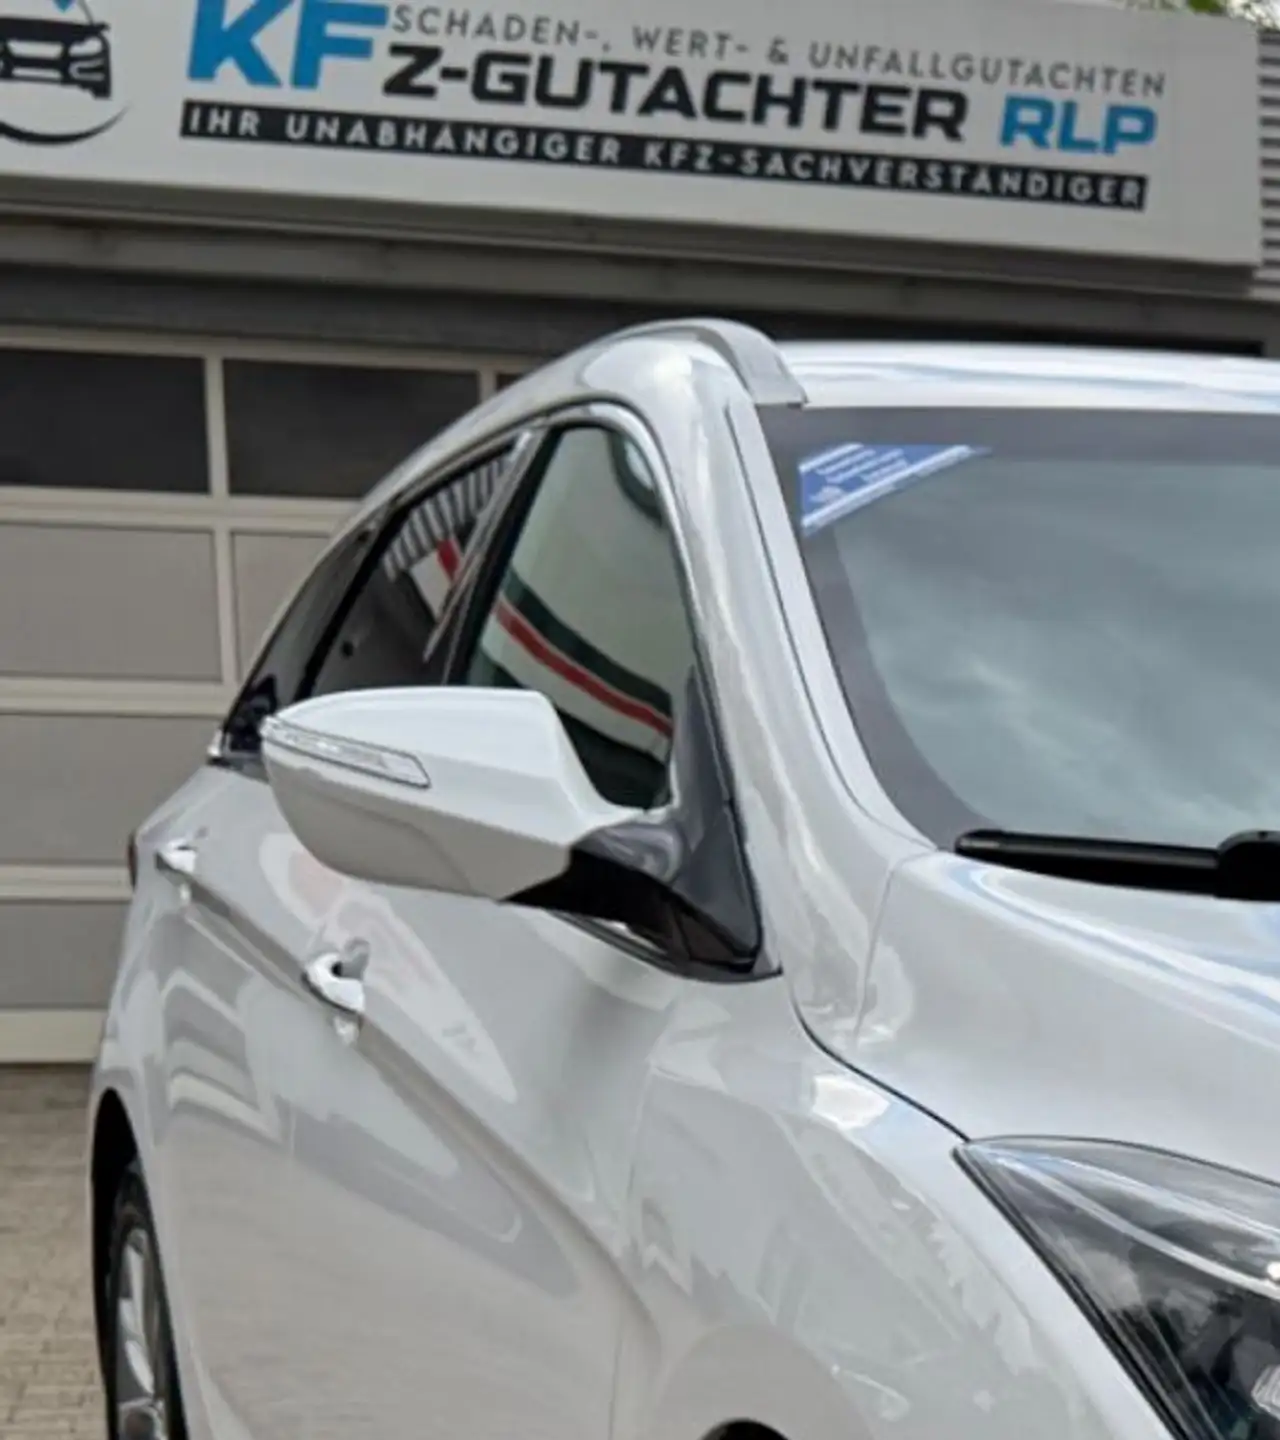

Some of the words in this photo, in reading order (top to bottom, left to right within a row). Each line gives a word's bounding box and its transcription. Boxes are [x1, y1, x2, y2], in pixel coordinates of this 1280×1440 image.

[632, 26, 749, 60] WERT-
[767, 36, 789, 65] &
[808, 40, 1167, 98] UNFALLGUTACHTEN
[189, 106, 261, 137] IHR
[1000, 92, 1158, 156] RLP
